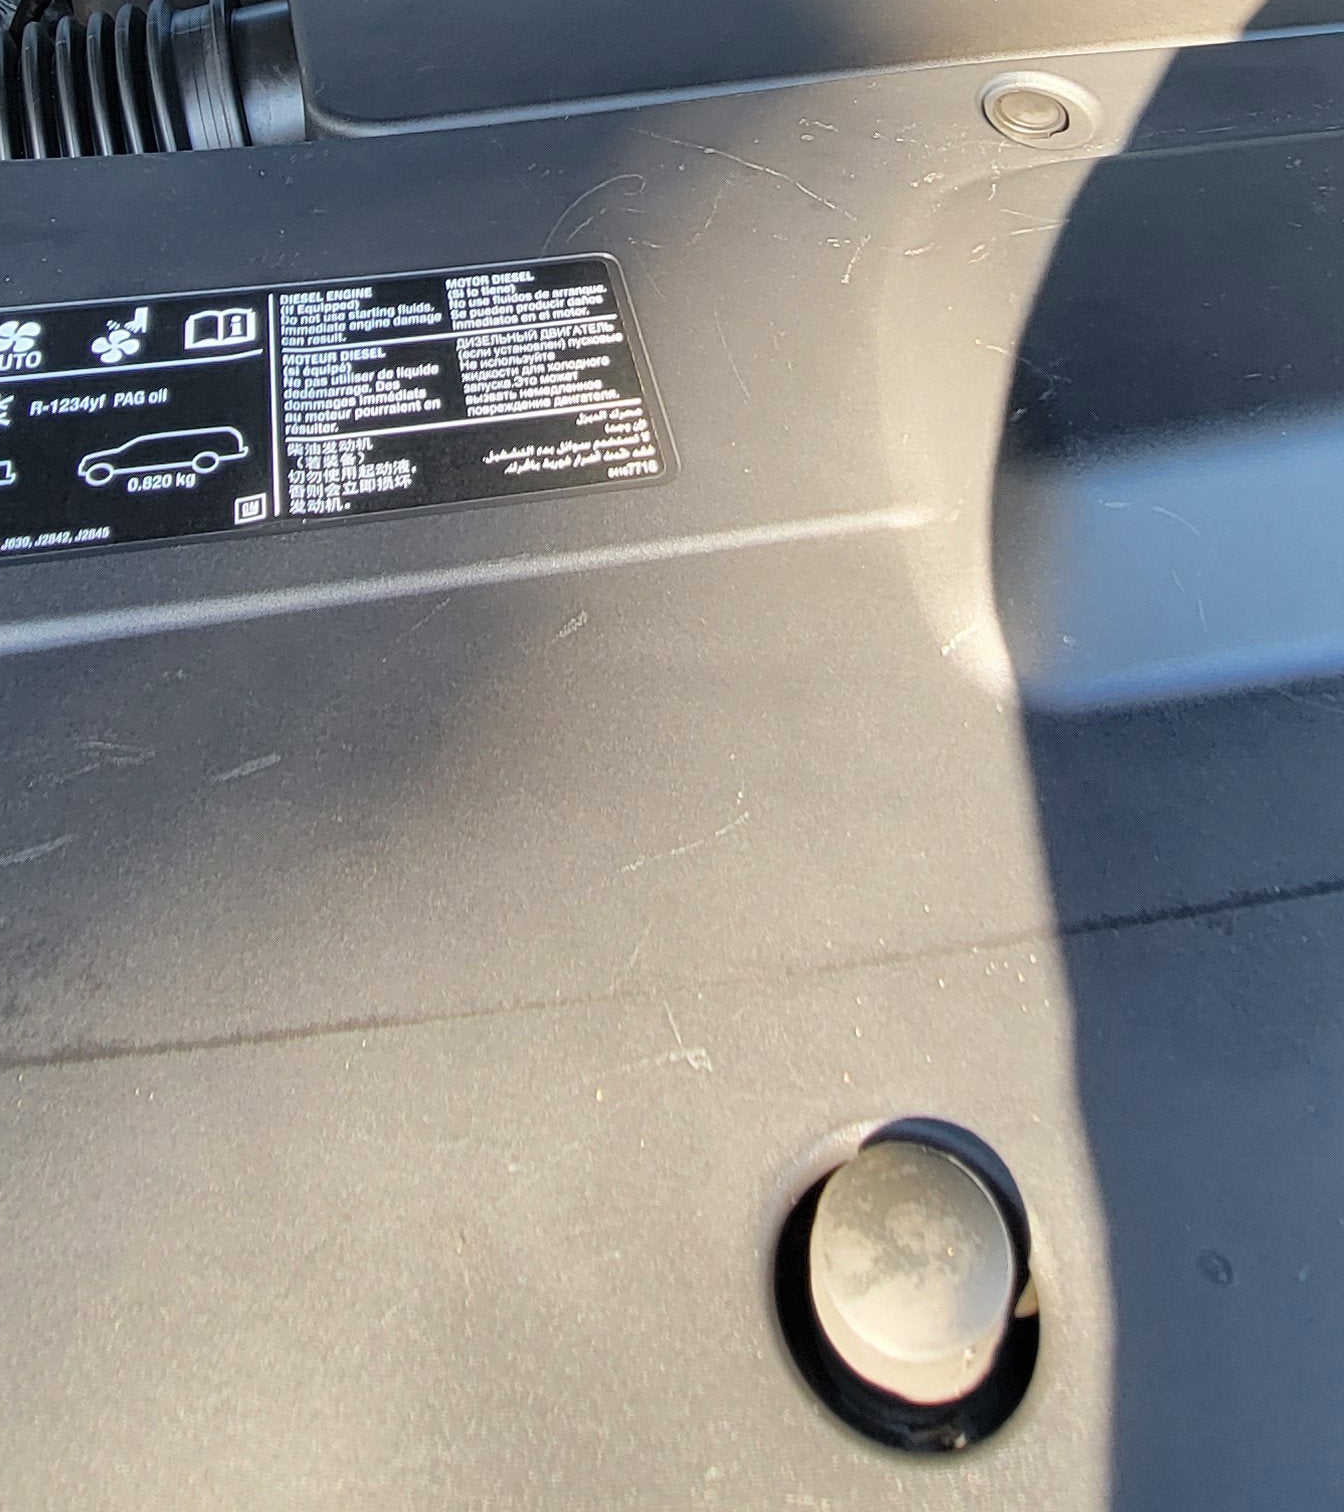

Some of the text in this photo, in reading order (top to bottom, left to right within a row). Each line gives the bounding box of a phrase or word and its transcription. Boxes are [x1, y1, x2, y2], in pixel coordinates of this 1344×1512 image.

[445, 271, 535, 290] MOTOR DIESEL
[280, 287, 373, 305] DIESEL ENGINE
[449, 299, 466, 310] No
[468, 297, 490, 308] use
[493, 292, 532, 306] fluidos
[534, 289, 550, 300] de
[466, 286, 479, 298] lo
[482, 284, 516, 296] tiene)
[281, 314, 298, 326] Do
[300, 313, 321, 324] not
[324, 312, 346, 322] use
[348, 306, 395, 320] starting
[297, 300, 360, 315] Equipped)
[450, 294, 604, 320] Se pueden producir daños
[521, 312, 536, 322] en
[538, 310, 550, 321] el
[552, 307, 590, 320] motor.
[282, 312, 442, 336] Immediate engine damage
[282, 333, 347, 346] can result.
[456, 322, 614, 350] ДИЗЕЛЬНЫЙ ДВИГАТЕЛЬ
[458, 332, 624, 361] (если установлен) пусковые
[282, 348, 387, 366] MOTEUR DIESEL
[460, 351, 556, 371] Не используйте
[284, 364, 440, 388] Ne pas utiliser de liquide
[303, 362, 352, 378] équipé)
[462, 356, 610, 383] жидкости для холодного
[540, 371, 578, 384] может
[376, 380, 400, 391] Des
[465, 380, 603, 406] вызвать немедленное
[29, 388, 168, 416] R-1234yf PAG oil
[284, 388, 426, 411] dommages immédiats
[468, 397, 552, 416] повреждение
[284, 398, 442, 423] au moteur pourraient en
[285, 423, 339, 436] résulter.
[176, 472, 196, 488] kg
